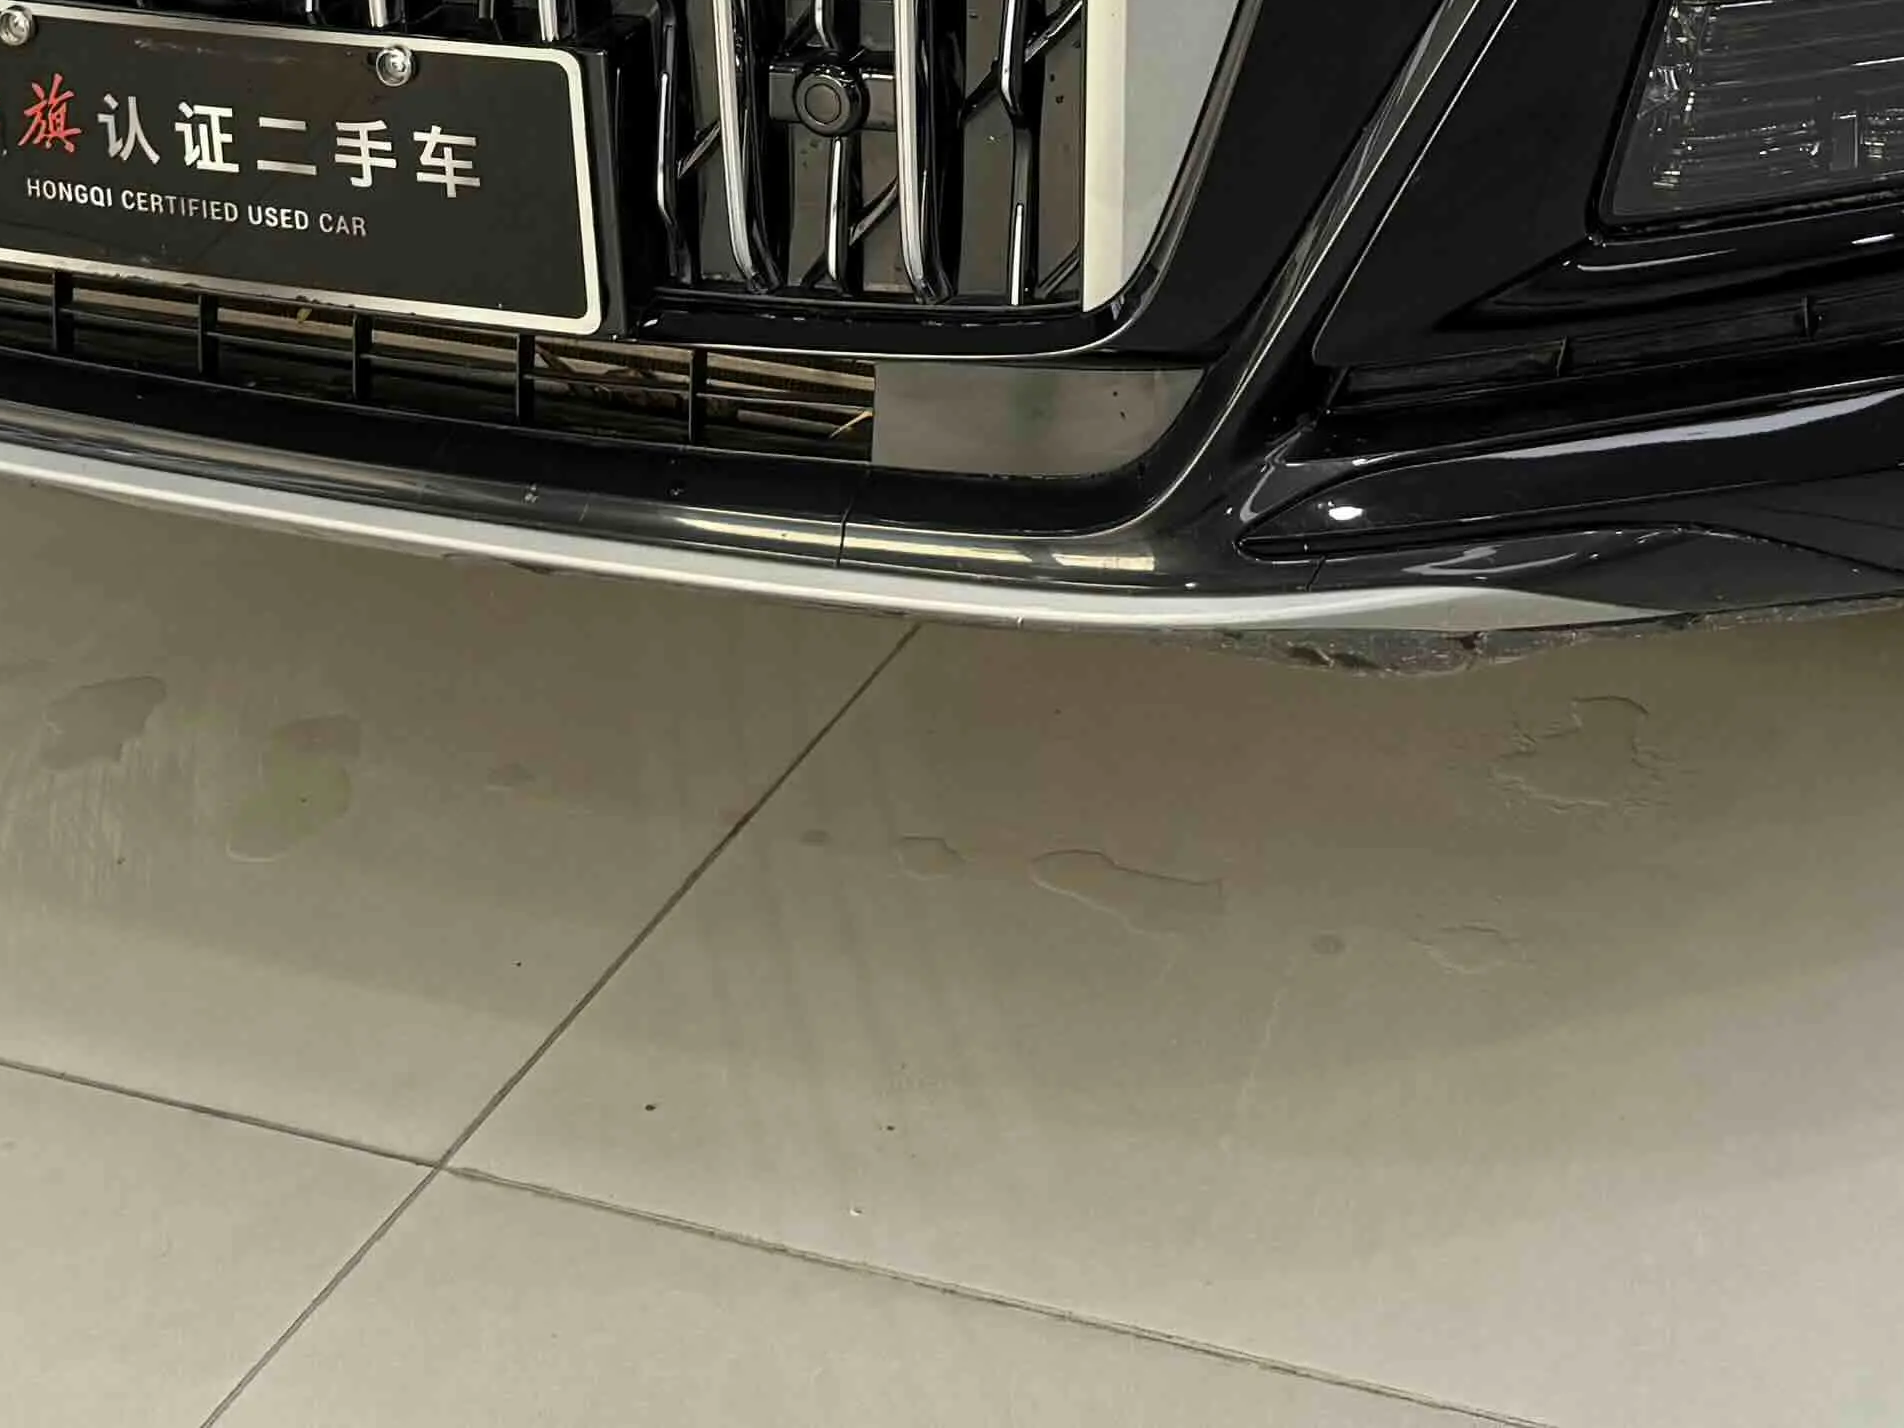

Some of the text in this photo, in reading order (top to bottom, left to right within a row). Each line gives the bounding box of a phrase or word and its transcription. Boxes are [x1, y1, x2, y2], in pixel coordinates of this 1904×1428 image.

[26, 177, 367, 237] HONGQI CERTIFIED USED CAR
